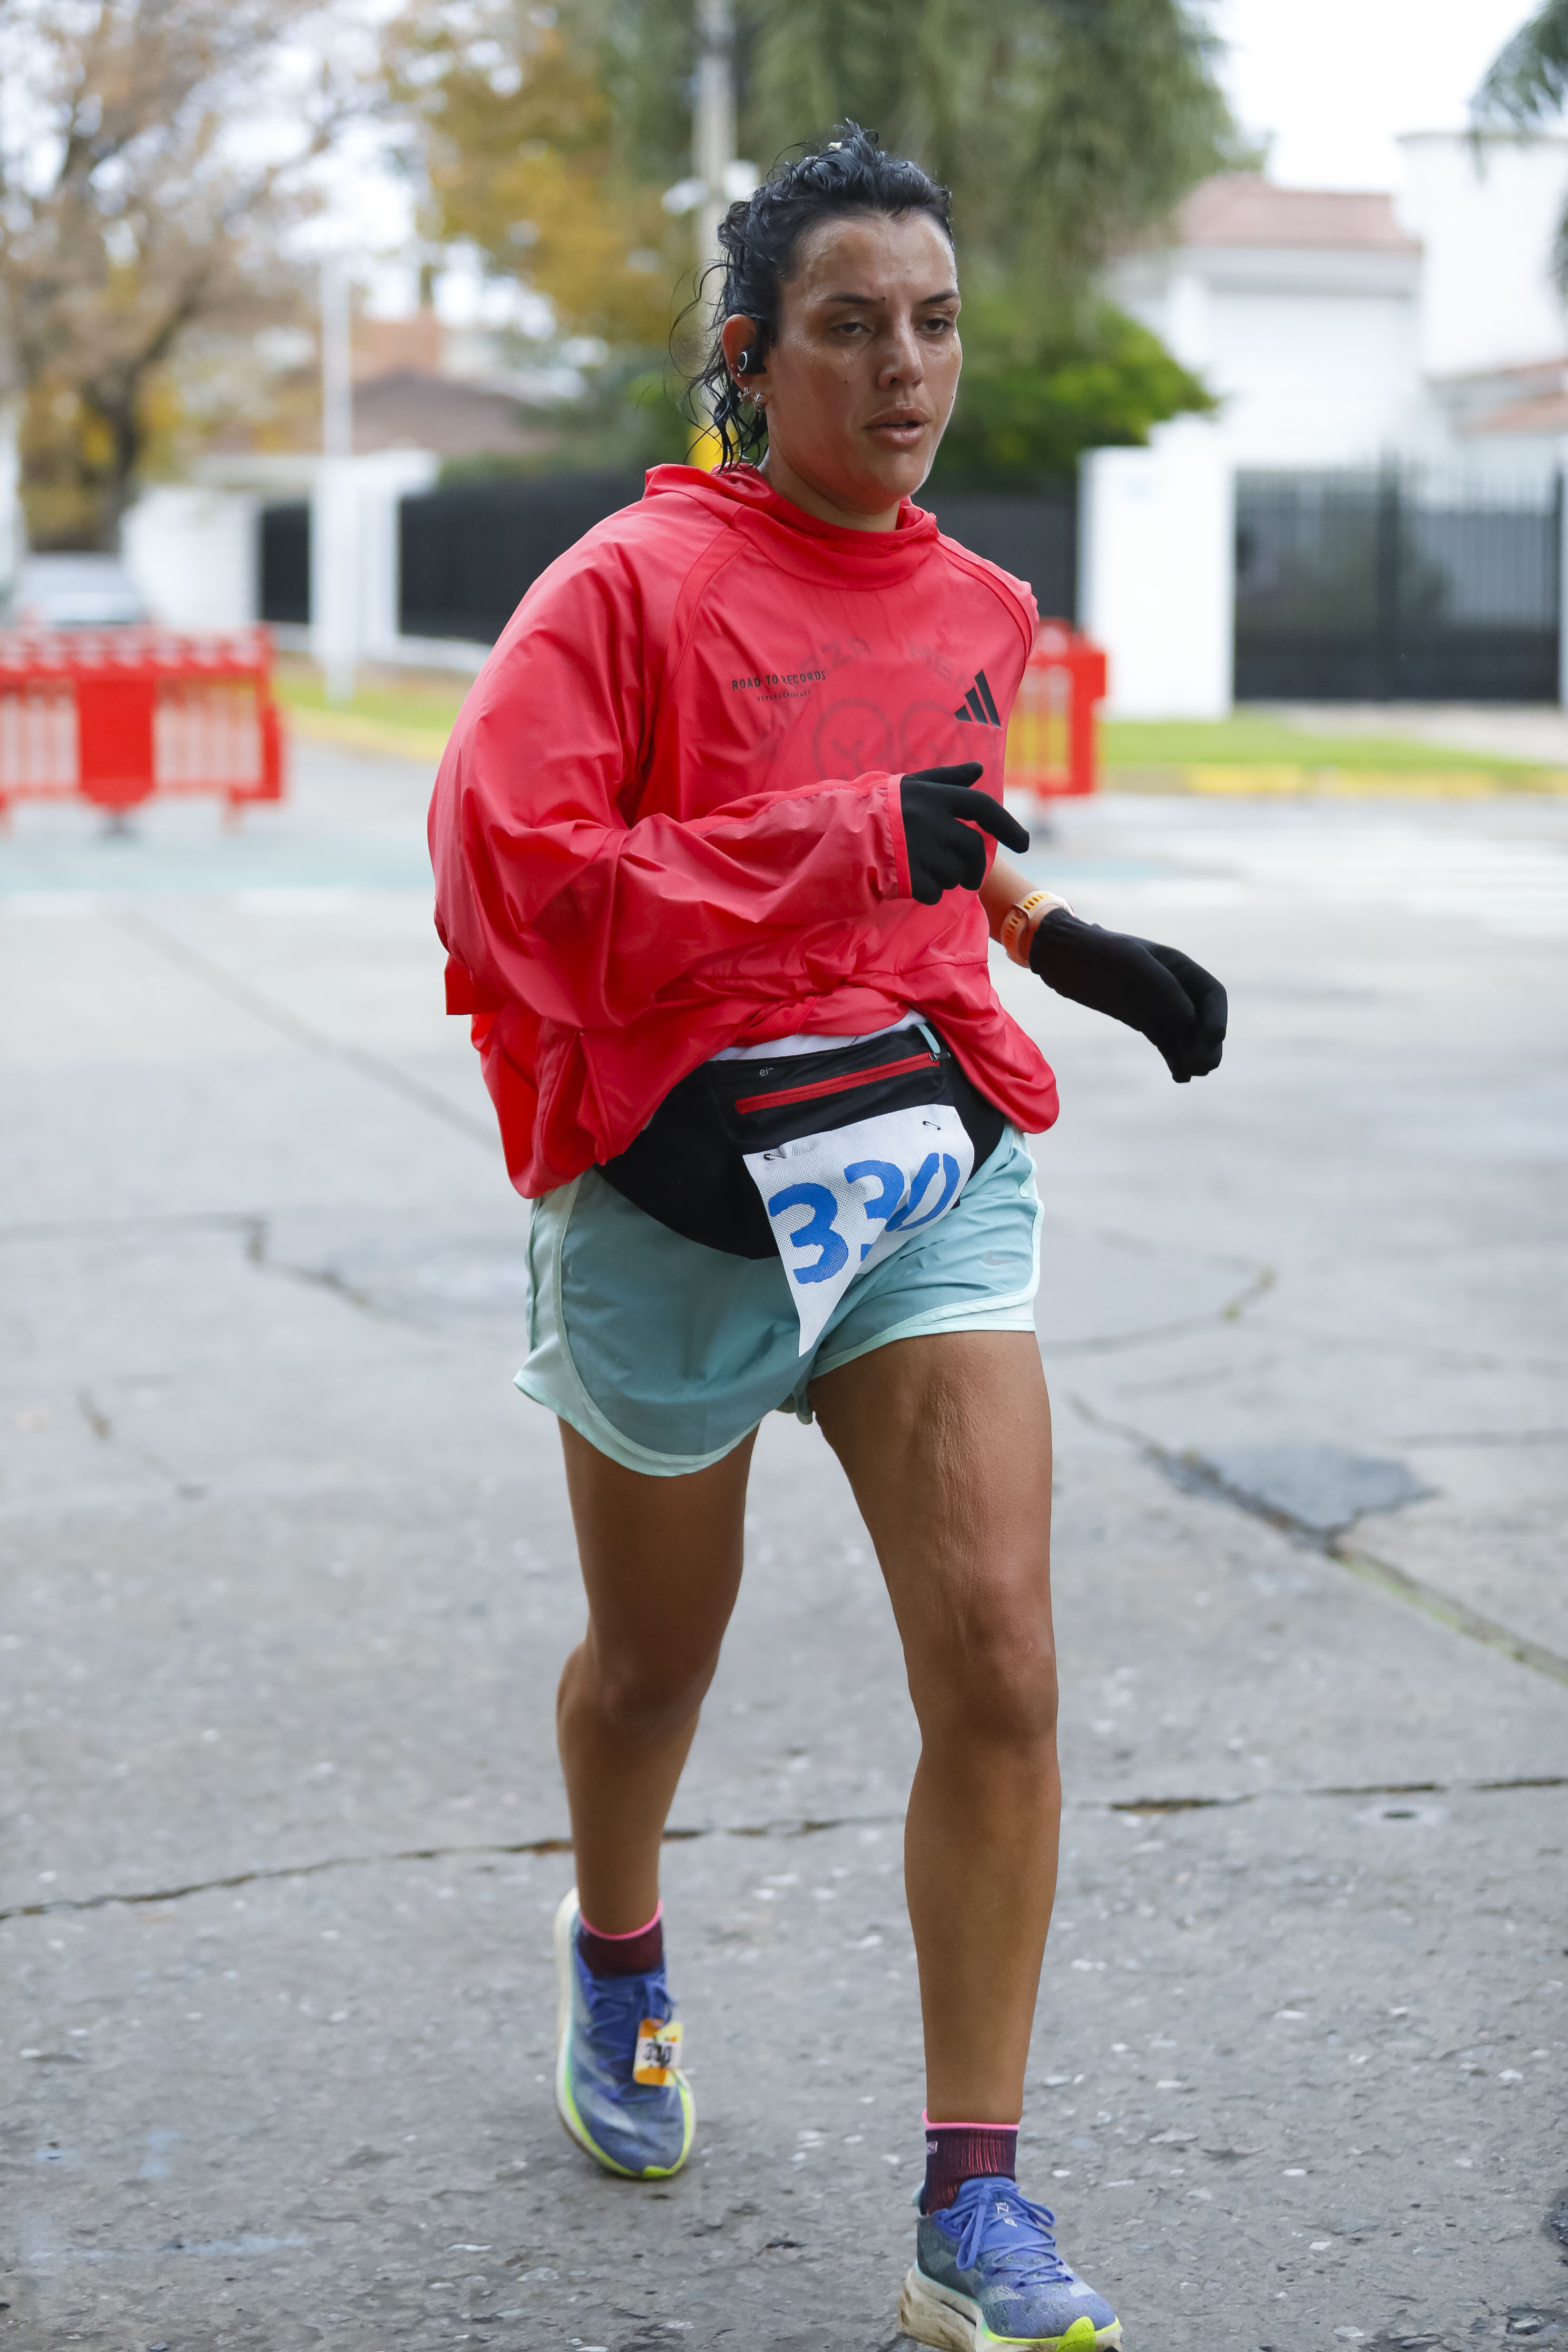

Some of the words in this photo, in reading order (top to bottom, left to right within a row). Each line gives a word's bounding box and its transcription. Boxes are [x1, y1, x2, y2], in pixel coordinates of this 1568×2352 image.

[732, 677, 761, 690] ROAD
[766, 675, 778, 685] TO
[781, 670, 826, 685] RECORDS
